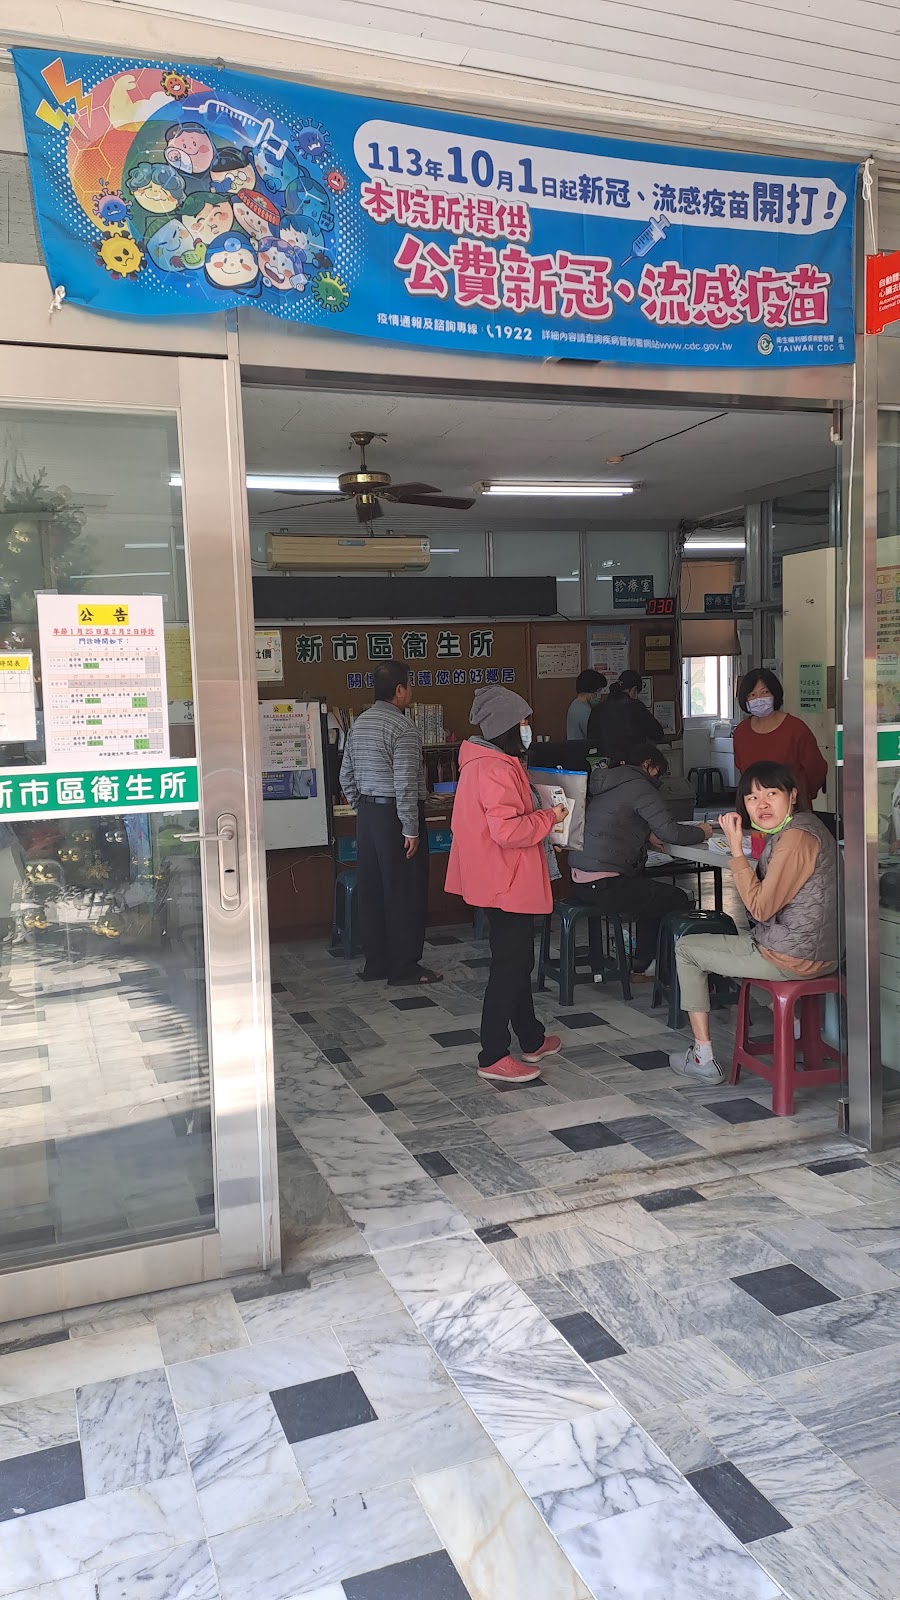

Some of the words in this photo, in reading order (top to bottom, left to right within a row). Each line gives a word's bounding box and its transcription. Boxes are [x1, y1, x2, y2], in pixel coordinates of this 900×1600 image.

[361, 179, 531, 240] 本院所提供
[394, 235, 832, 327] 公費新冠、流感疫苗
[496, 324, 533, 341] 1922
[777, 344, 814, 352] TAIWAN
[817, 344, 835, 352] CDC
[614, 579, 651, 593] 診療室
[649, 599, 674, 614] 030
[295, 629, 494, 663] 新市區衛生所
